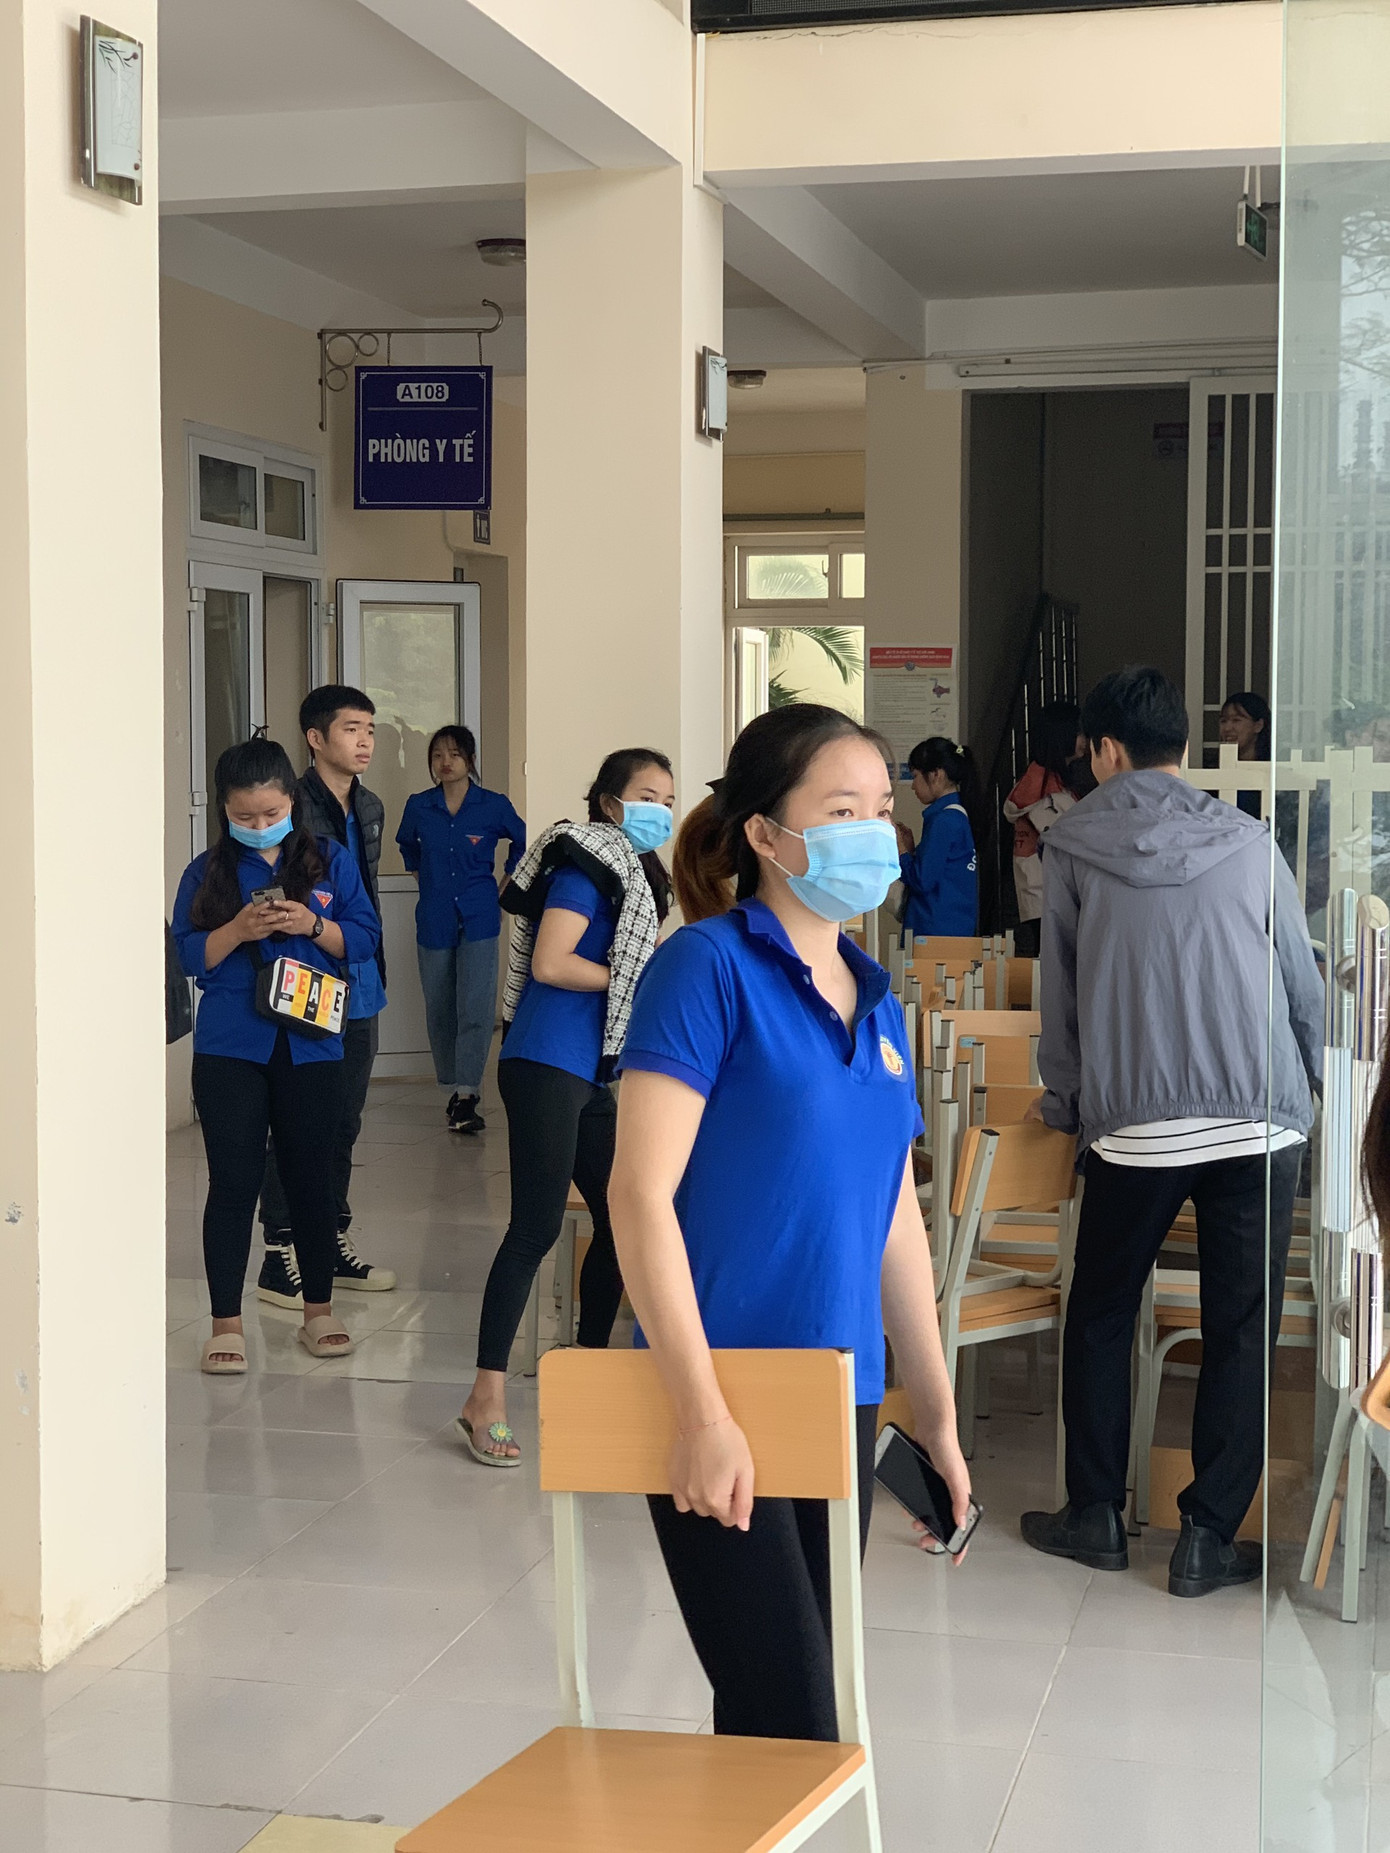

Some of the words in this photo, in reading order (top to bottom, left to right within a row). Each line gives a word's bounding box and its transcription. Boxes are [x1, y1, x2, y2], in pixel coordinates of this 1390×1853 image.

[400, 384, 445, 400] A108
[368, 433, 430, 463] PHÒNG
[435, 439, 447, 462] Y
[452, 430, 477, 463] TẾ
[284, 970, 342, 1012] PEACE
